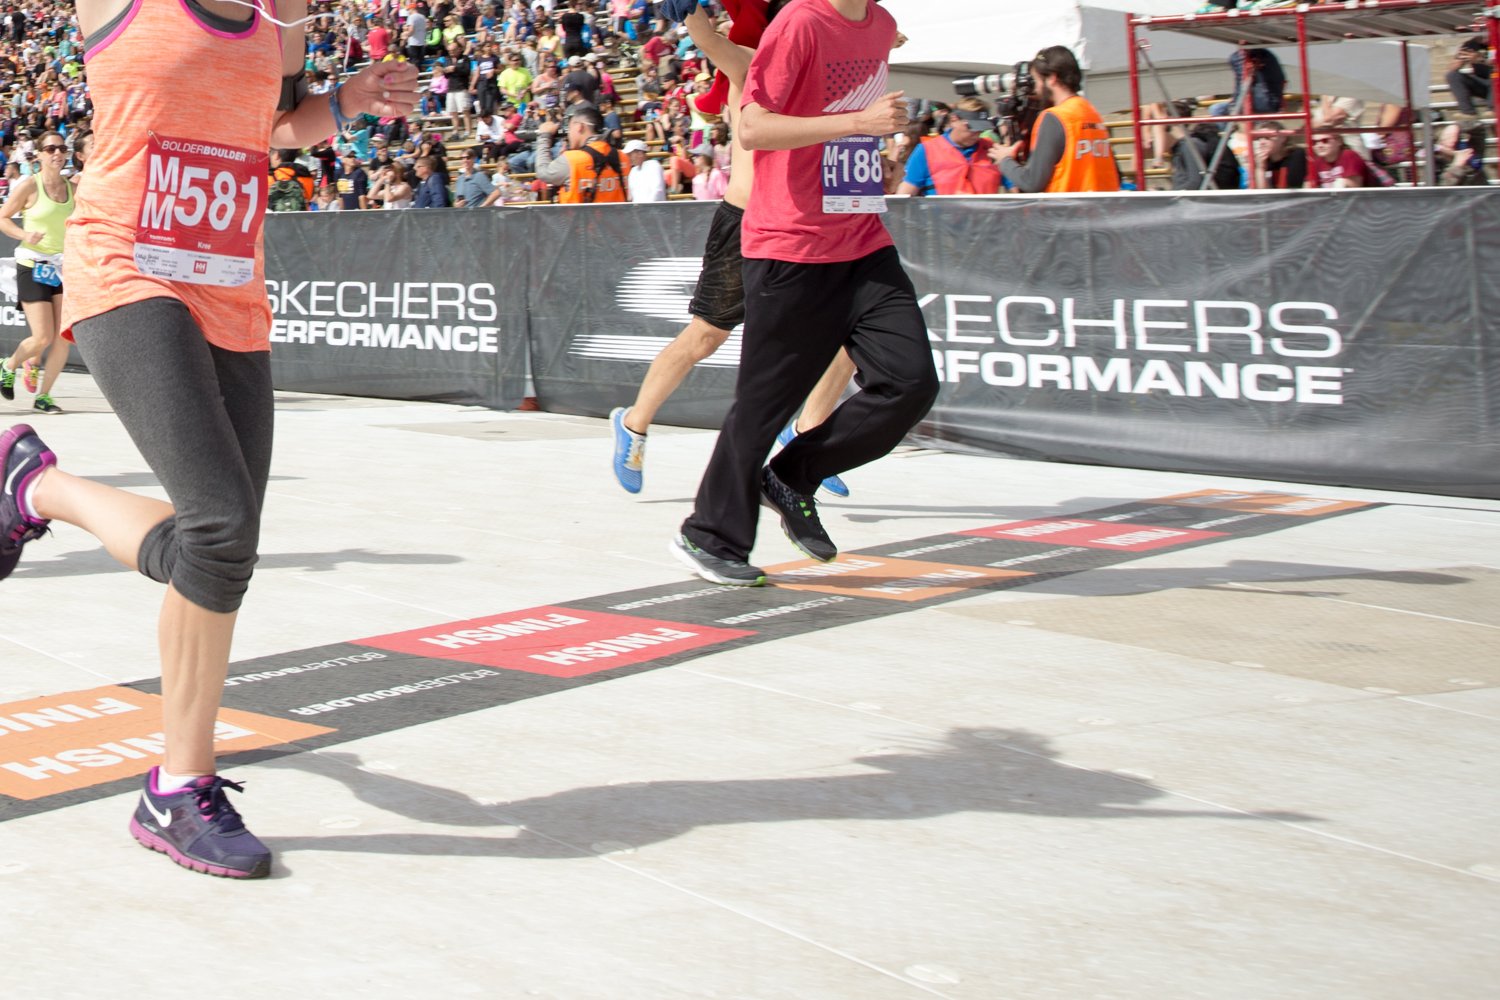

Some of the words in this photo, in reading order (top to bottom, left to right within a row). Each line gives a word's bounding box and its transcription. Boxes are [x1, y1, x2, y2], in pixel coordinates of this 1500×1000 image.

[161, 140, 247, 162] BOLDERBOULDER
[264, 280, 498, 322] SKECHERS
[269, 319, 499, 353] ERFORMANCE
[996, 519, 1097, 538] FINISH
[1090, 528, 1189, 547] FINISH
[861, 568, 988, 595] FINISH
[418, 613, 589, 649] FINISH
[528, 627, 699, 666] FINISH
[289, 669, 501, 717] BOLDERBOULDER
[0, 721, 256, 781] FNISH
